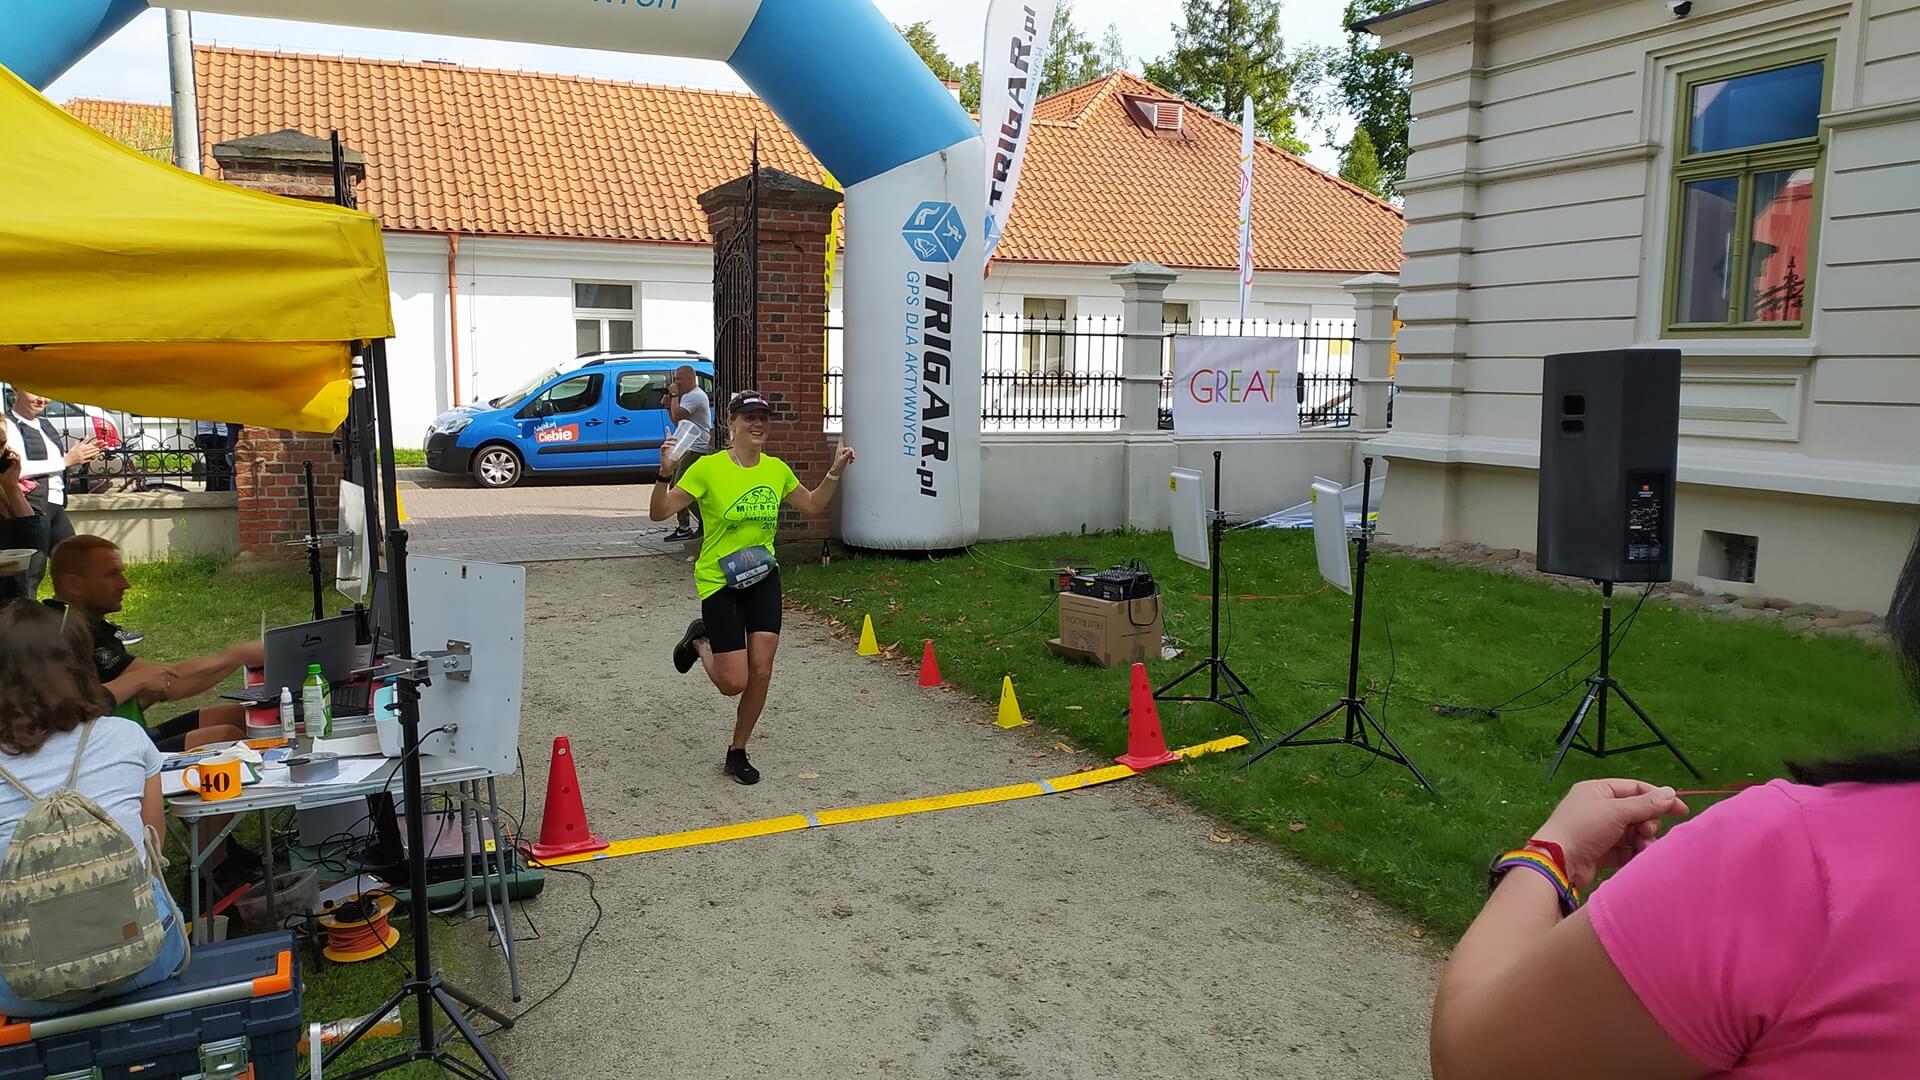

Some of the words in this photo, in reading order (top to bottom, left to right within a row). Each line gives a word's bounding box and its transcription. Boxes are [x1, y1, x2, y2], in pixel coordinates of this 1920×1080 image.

[989, 4, 1037, 207] TRIGAR.pl
[905, 270, 919, 307] GPS
[905, 311, 918, 346] DLA
[916, 271, 953, 498] TRIGAR.pl
[1190, 368, 1280, 404] GREAT
[903, 351, 918, 457] AKTYWNYCH
[538, 428, 573, 442] Ciebie
[201, 772, 230, 793] 40
